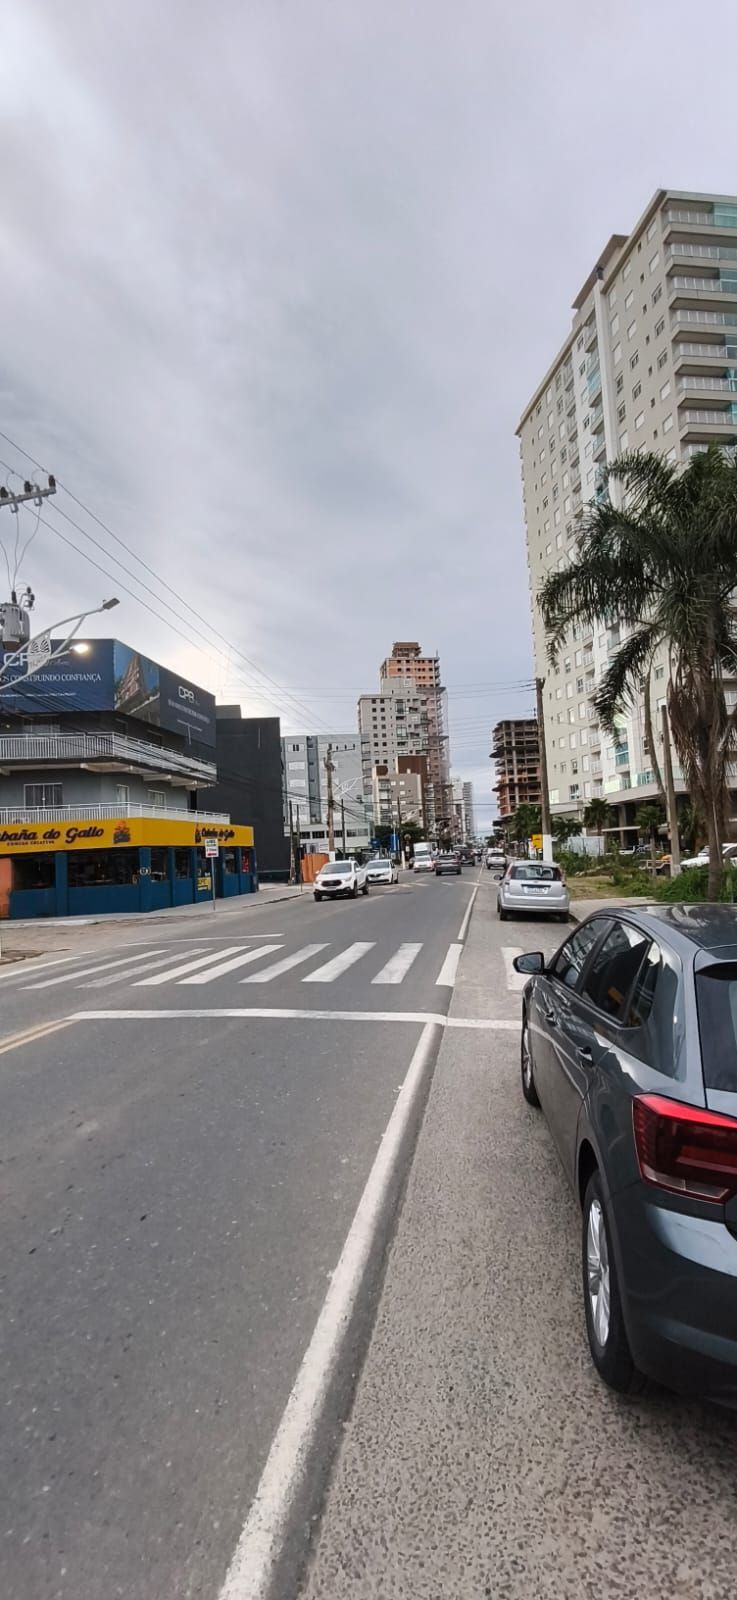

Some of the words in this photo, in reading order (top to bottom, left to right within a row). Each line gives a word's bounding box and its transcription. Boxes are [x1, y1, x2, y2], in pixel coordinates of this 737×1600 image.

[61, 673, 102, 683] CONFIANÇA
[0, 829, 37, 842] baña
[42, 829, 60, 840] do
[65, 826, 104, 844] Gallo
